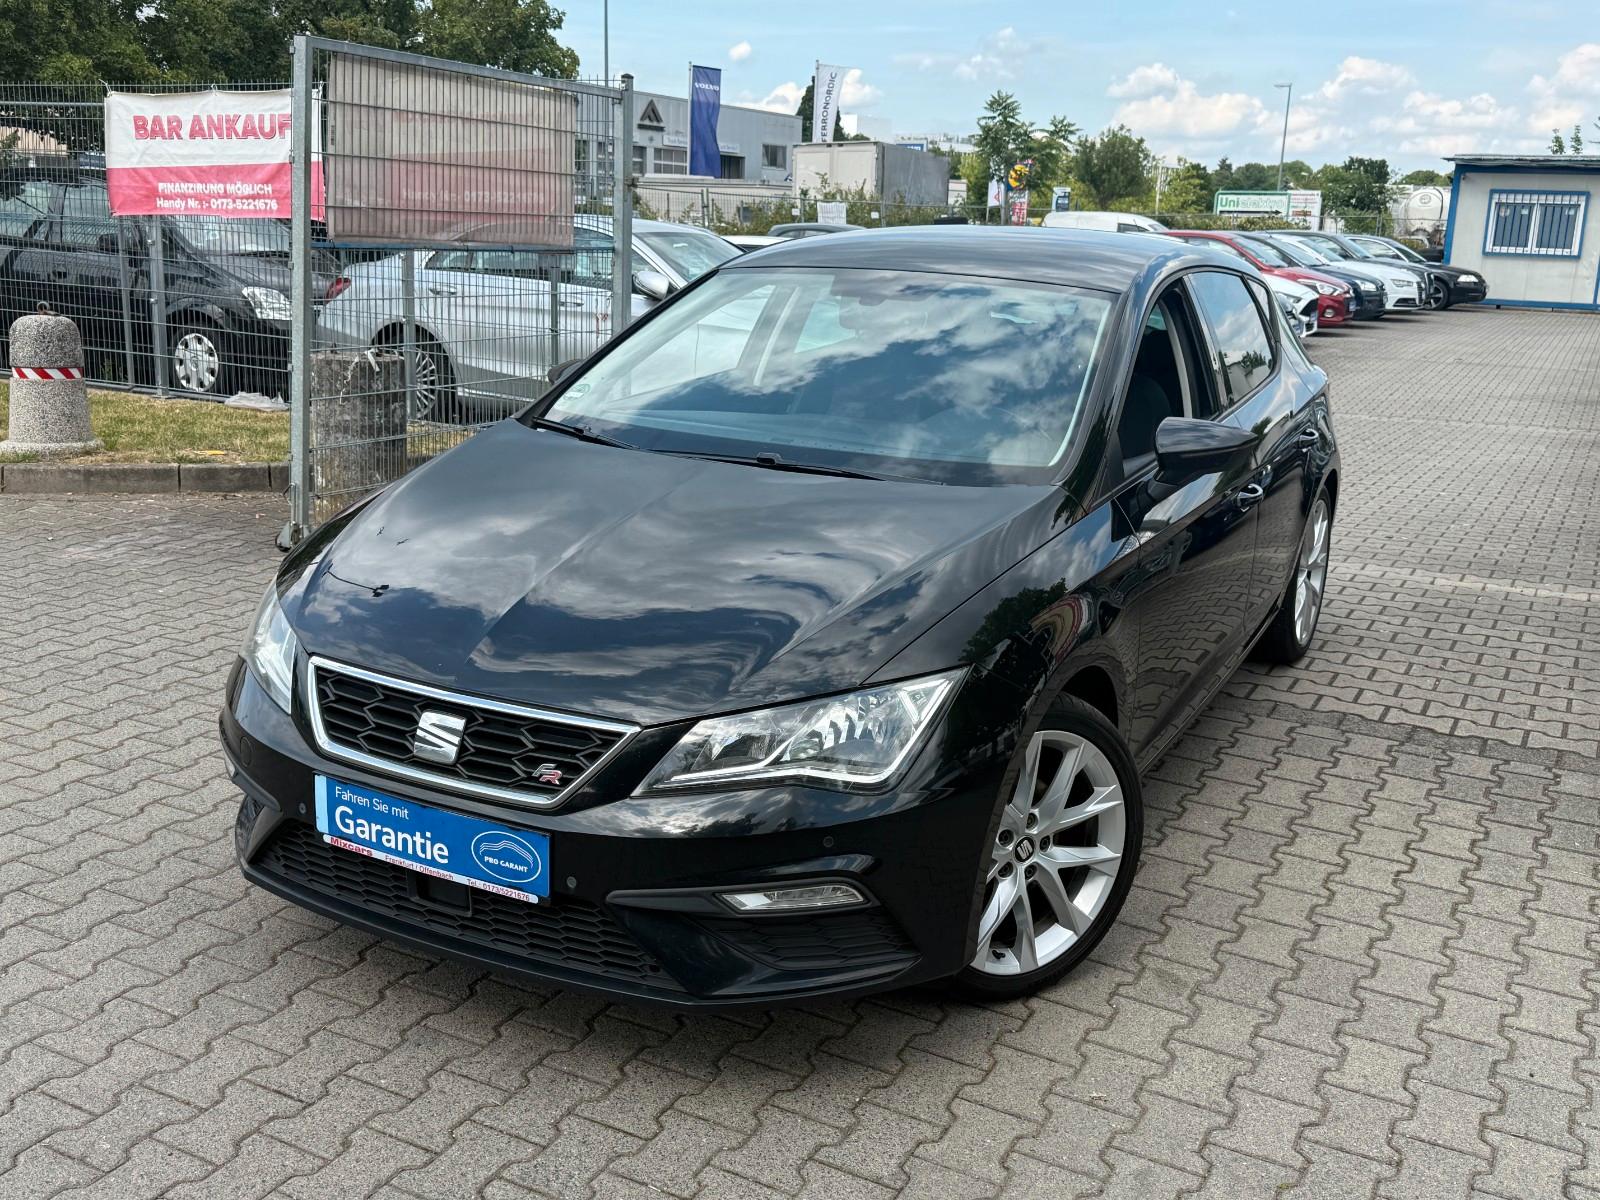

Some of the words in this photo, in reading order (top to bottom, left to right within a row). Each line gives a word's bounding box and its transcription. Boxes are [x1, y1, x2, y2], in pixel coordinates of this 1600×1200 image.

[694, 82, 720, 91] VOLVO
[820, 72, 837, 143] FERRONORDIC
[133, 115, 183, 140] BAR
[188, 113, 292, 140] ANKAUF
[158, 182, 224, 194] FINANZIRUNG
[226, 181, 273, 195] MÖGLICH
[156, 198, 186, 211] Handy
[210, 198, 279, 210] 0173-5221676
[335, 786, 370, 808] Fahren
[372, 798, 389, 814] Sie
[391, 806, 409, 820] mit
[335, 805, 449, 864] Garantie
[330, 836, 373, 857] Mixcars
[484, 855, 499, 865] PRO
[500, 860, 529, 873] GARANT
